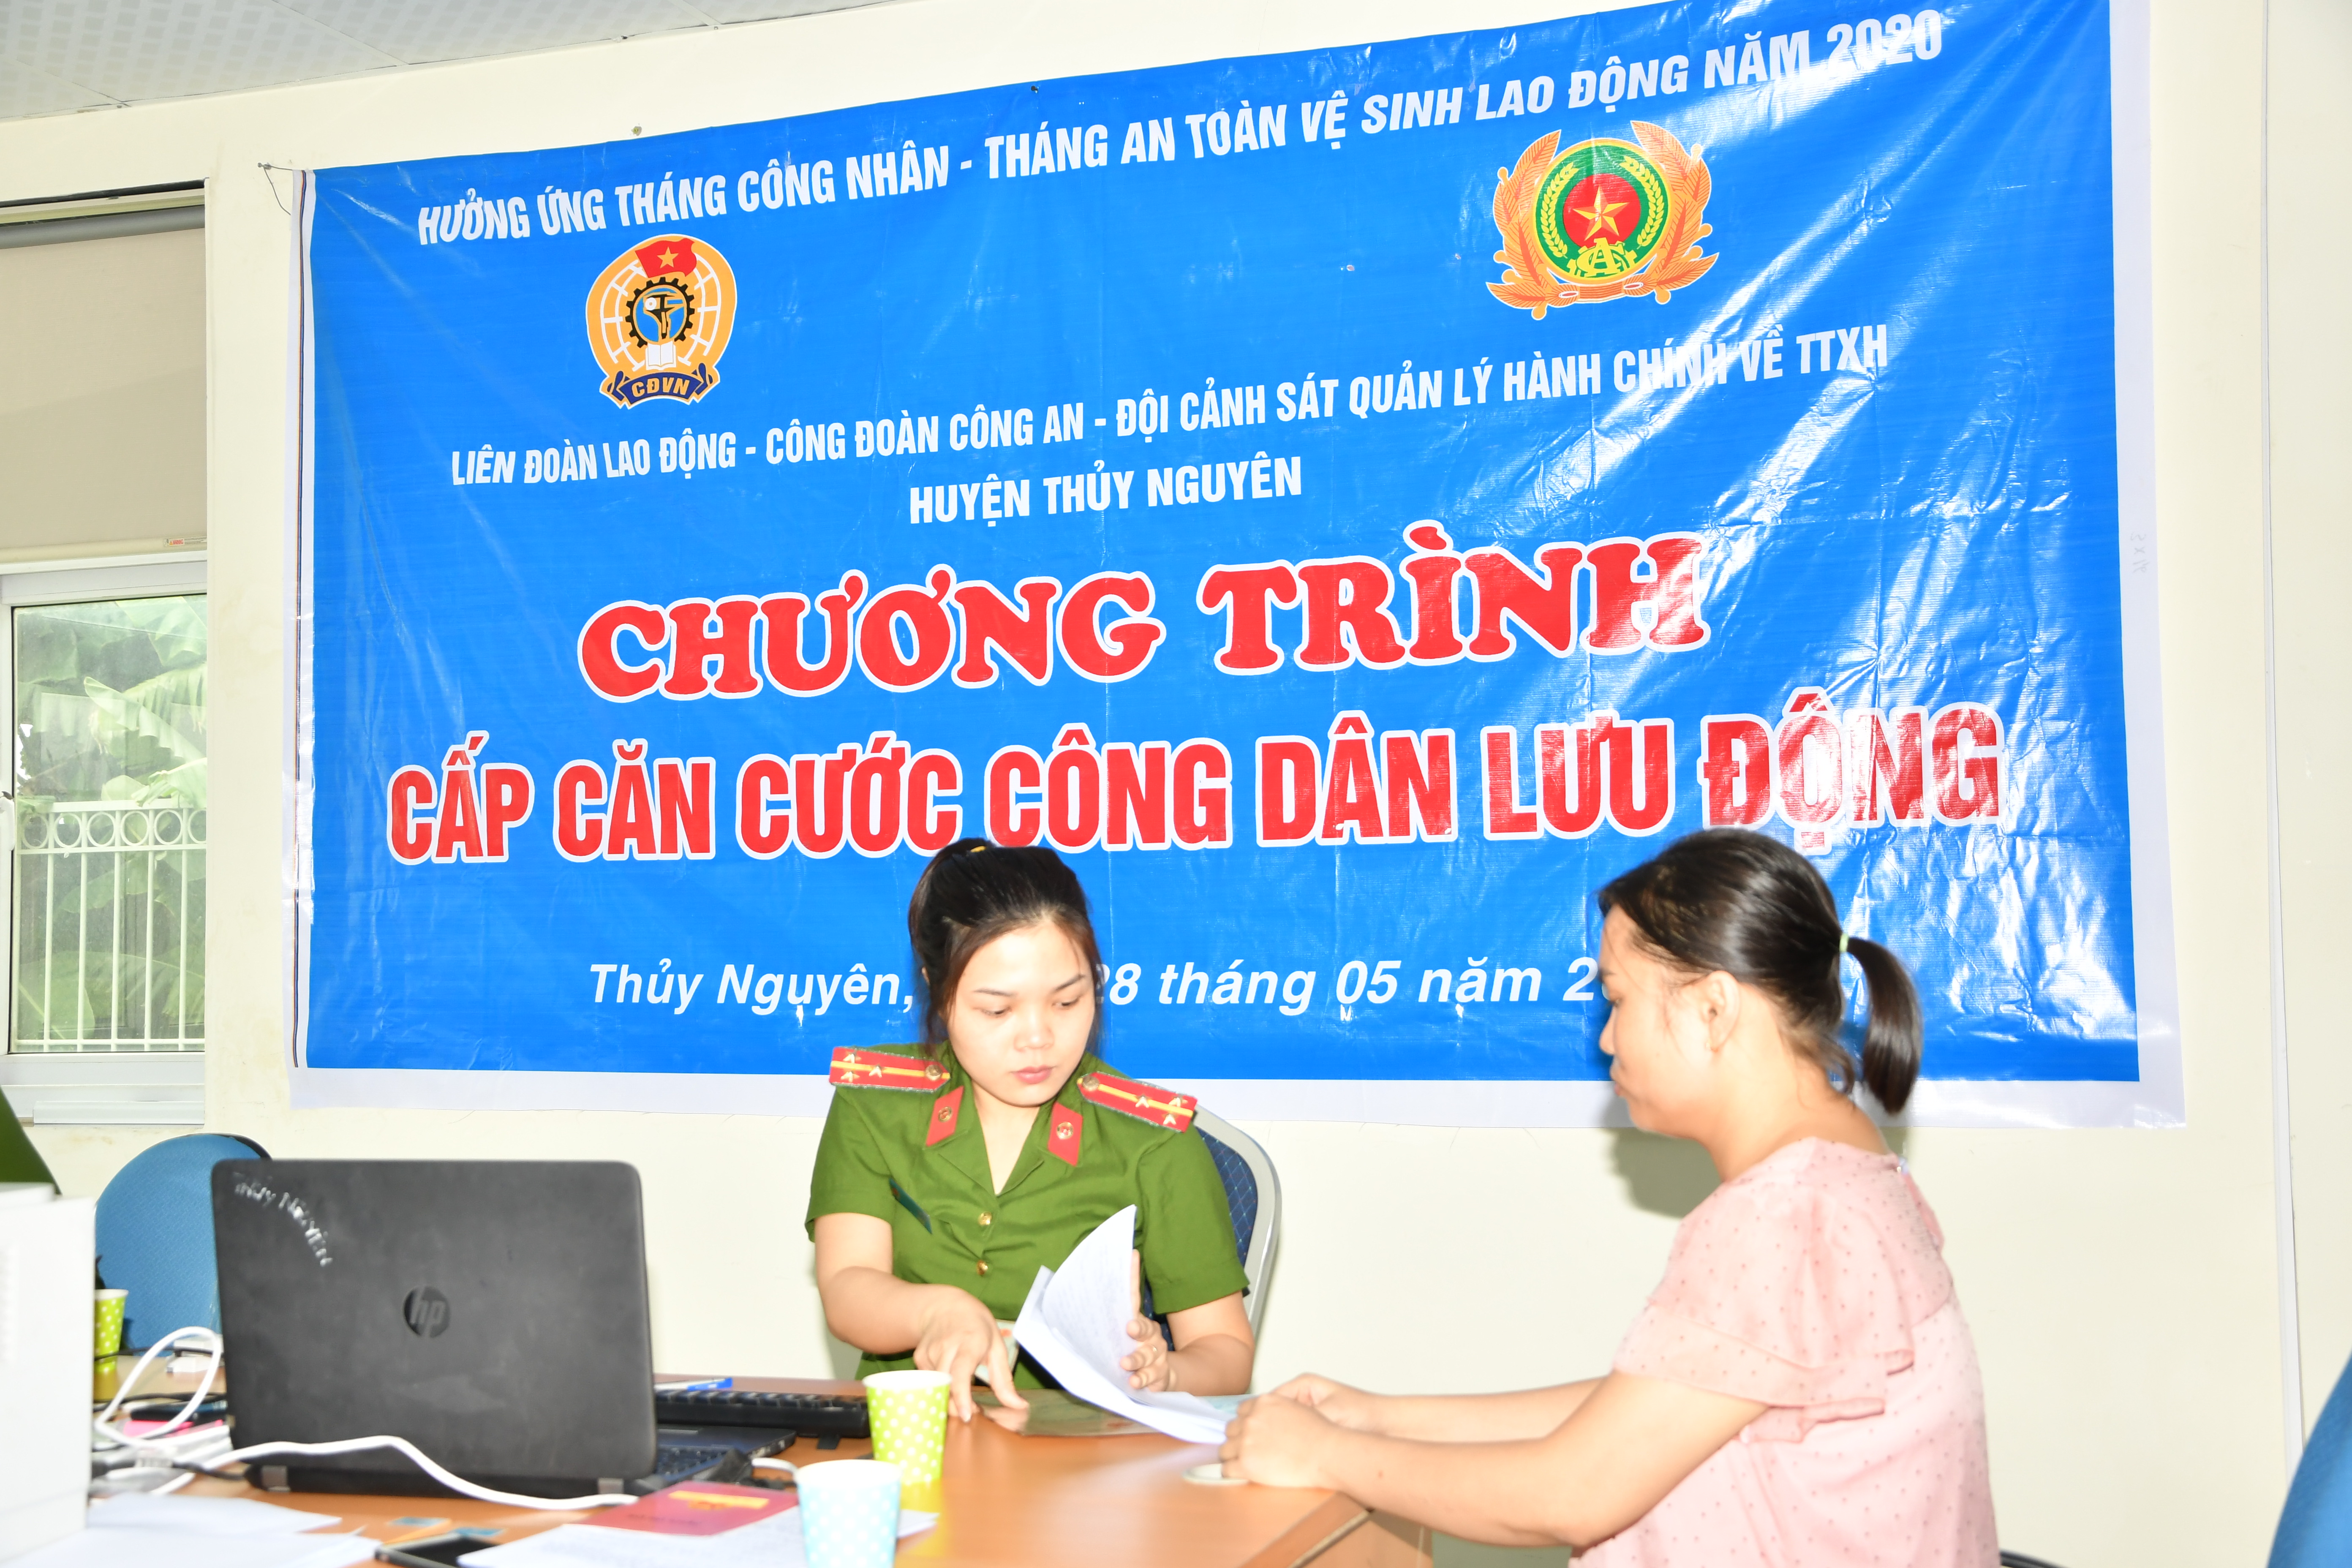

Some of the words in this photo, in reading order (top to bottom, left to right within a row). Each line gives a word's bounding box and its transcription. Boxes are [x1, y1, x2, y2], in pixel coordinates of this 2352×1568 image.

[419, 188, 530, 245] HƯỞNG
[537, 186, 606, 235] ỨNG
[615, 172, 727, 226] THÁNG
[738, 159, 835, 212] CÔNG
[847, 140, 948, 199] NHÂN
[961, 160, 972, 169] -
[985, 121, 1107, 178] THÁNG
[1121, 117, 1175, 163] AN
[1185, 101, 1287, 158] TOÀN
[1302, 90, 1348, 149] VỆ
[1362, 87, 1462, 133] SINH
[1476, 76, 1554, 120] LAO
[1568, 55, 1688, 112] ĐỘNG
[1704, 30, 1811, 88] NĂM
[1826, 10, 1942, 71] 2020
[452, 444, 515, 485] LIÊN
[524, 439, 597, 483] ĐOÀN
[603, 439, 650, 477] LAO
[659, 428, 735, 479] ĐỘNG
[766, 419, 845, 464] CÔNG
[855, 410, 938, 457] ĐOÀN
[950, 404, 1033, 450] CÔNG
[1043, 403, 1083, 443] AN
[1116, 389, 1168, 442] ĐỘI
[1181, 377, 1265, 431] CẢNH
[1277, 373, 1338, 421] SÁT
[1350, 360, 1442, 419] QUẢN
[1454, 357, 1492, 406] LÝ
[1504, 351, 1600, 401] HÀNH
[1614, 338, 1728, 392] CHÍNH
[1740, 324, 1785, 381] VỀ
[1797, 324, 1888, 374] TTXH
[632, 377, 690, 397] CĐVN
[910, 474, 1029, 527] HUYỆN
[1043, 460, 1134, 514] THỦY
[1148, 451, 1301, 506] NGUYÊN
[577, 564, 1167, 703] CHƯƠNG
[1196, 520, 1711, 675] TRÌNH
[387, 730, 535, 865] CẤP
[553, 738, 716, 862] CĂN
[735, 730, 963, 860] CƯỚC
[984, 723, 1233, 854] CÔNG
[1256, 710, 1458, 846] DÂN
[1480, 710, 1674, 841] LƯU
[1697, 686, 2004, 855] ĐỘNG
[590, 958, 704, 1015] Thủy
[717, 963, 913, 1015] Nguyên,
[1159, 960, 1316, 1016] tháng
[1336, 960, 1401, 1004] 05
[1418, 956, 1541, 1002] năm
[1563, 956, 1609, 1001] 2
[409, 1288, 446, 1338] hp
